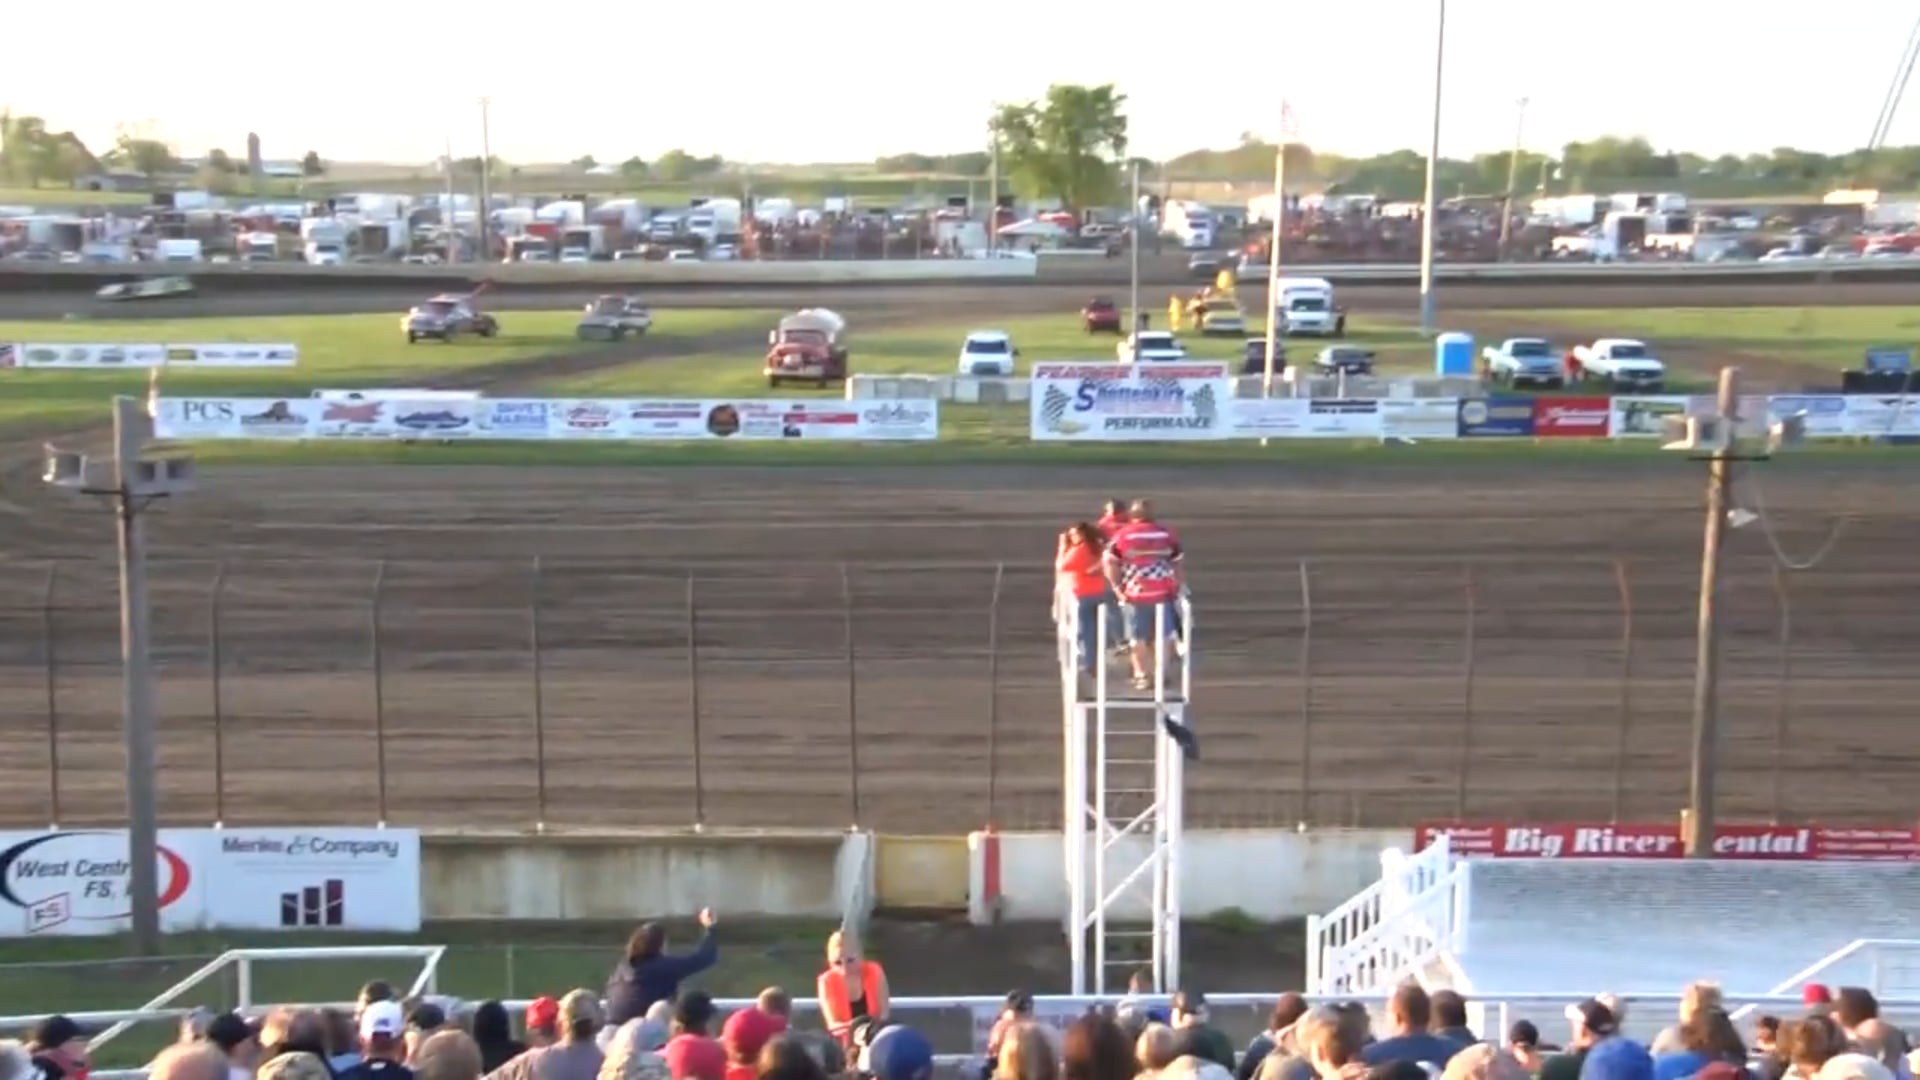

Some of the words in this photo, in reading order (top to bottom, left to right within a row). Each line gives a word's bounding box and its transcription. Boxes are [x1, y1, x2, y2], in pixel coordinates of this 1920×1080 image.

[182, 401, 234, 421] PCS
[1104, 416, 1213, 431] PERFORMANCE
[287, 835, 307, 856] &
[309, 836, 399, 858] Company
[1504, 828, 1564, 857] Big
[1574, 828, 1676, 853] River
[1712, 829, 1810, 853] ental
[16, 860, 68, 879] West
[75, 860, 131, 878] Centr
[34, 902, 62, 925] FS
